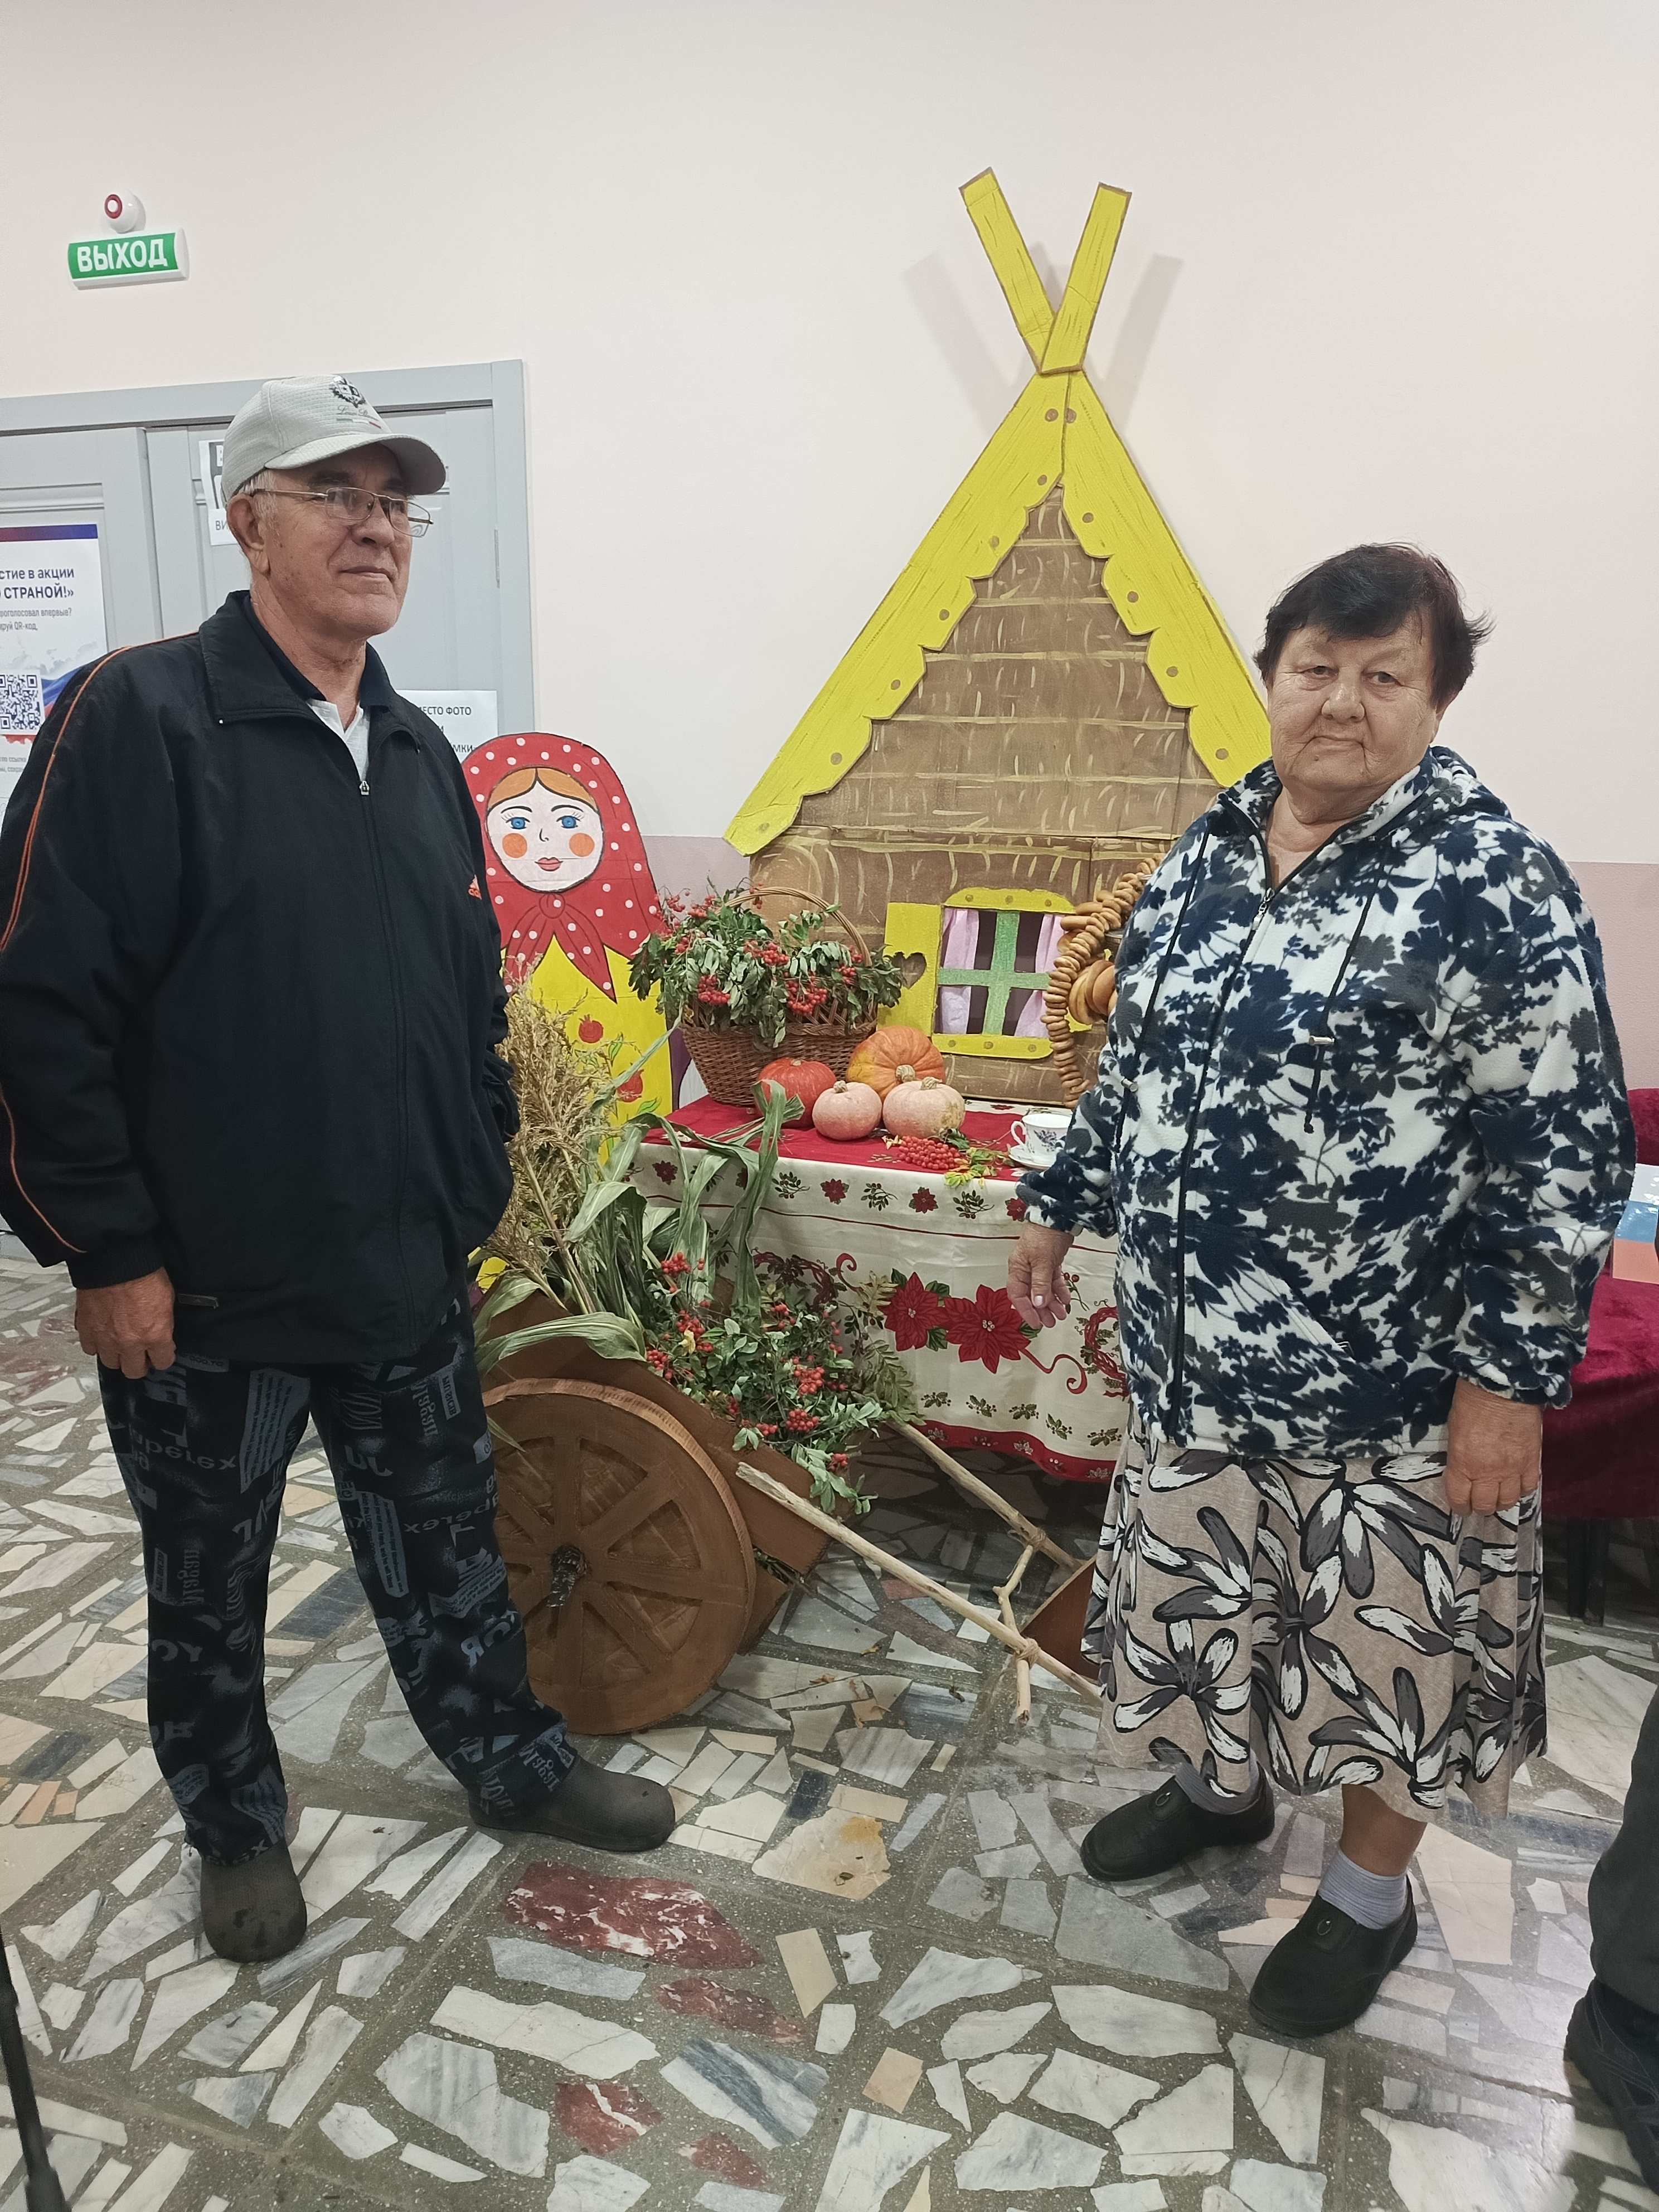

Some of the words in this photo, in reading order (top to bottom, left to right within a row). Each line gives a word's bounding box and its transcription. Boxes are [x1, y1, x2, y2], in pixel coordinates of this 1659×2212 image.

[77, 239, 168, 273] ВЫХОД
[215, 520, 229, 531] ВИ
[28, 570, 35, 579] в
[38, 569, 74, 580] акции
[4, 583, 74, 599] СТРАНОЙ!»
[41, 607, 72, 618] впервые?
[446, 706, 472, 715] ФОТО
[453, 744, 476, 753] МКИ
